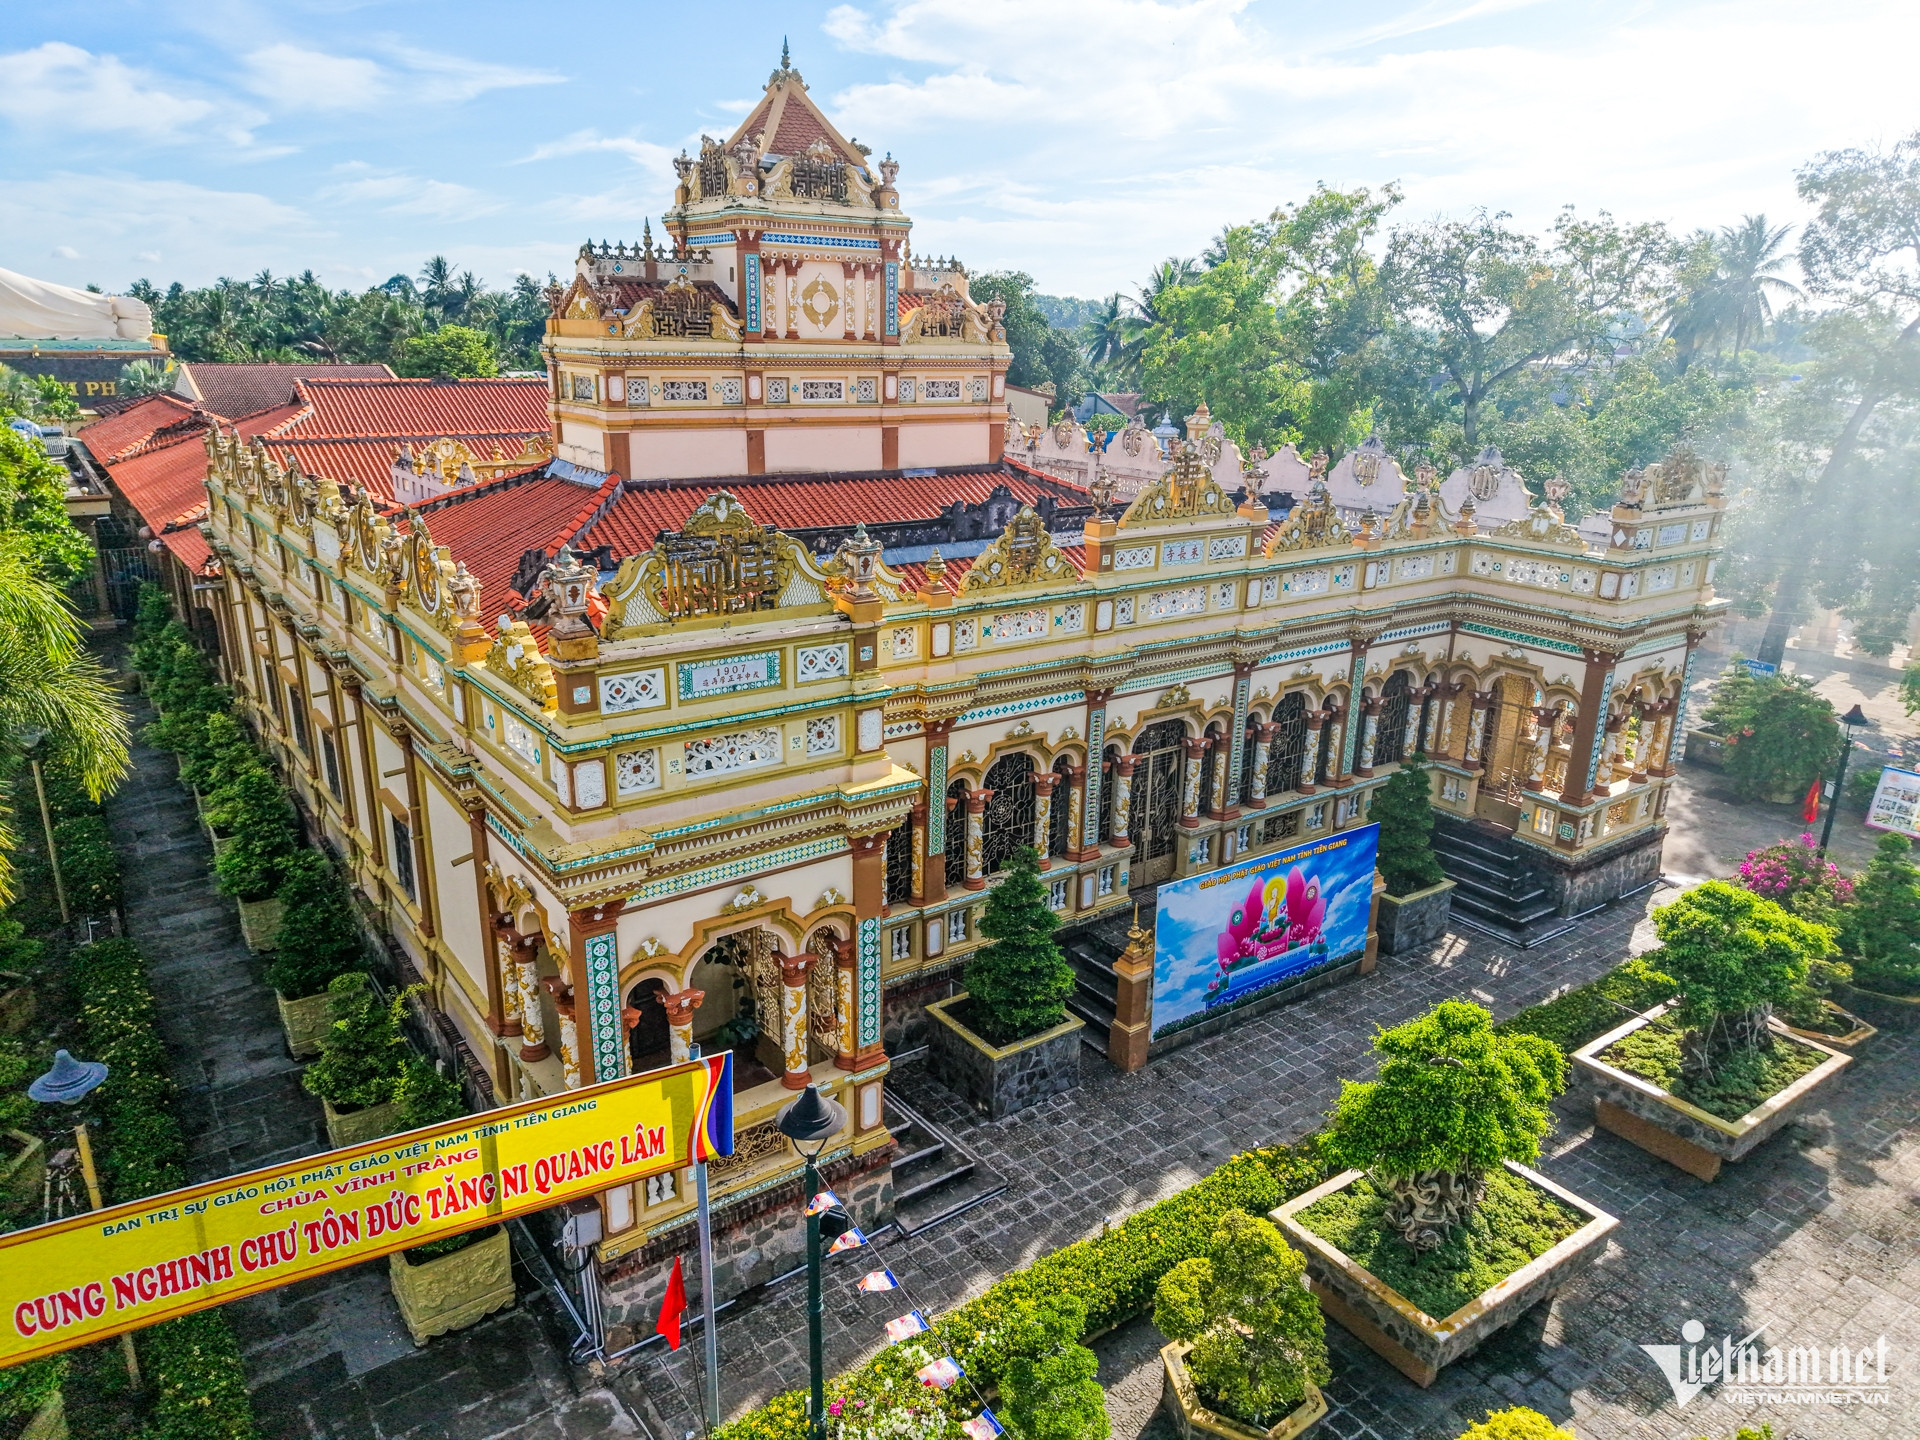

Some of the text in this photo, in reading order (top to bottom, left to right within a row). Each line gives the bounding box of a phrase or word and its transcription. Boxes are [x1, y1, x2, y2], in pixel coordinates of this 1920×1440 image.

[716, 664, 746, 677] 1907
[1199, 878, 1217, 890] GIÁO
[1217, 874, 1231, 884] HỘI
[1232, 868, 1249, 880] PHẬT
[1249, 863, 1266, 874] GIÁO
[1267, 858, 1281, 870] VIỆT
[1282, 855, 1297, 864] NAM
[1313, 844, 1327, 855] TIỀN
[1328, 838, 1347, 850] GIANG
[102, 1100, 597, 1237] BAN TRỊ SỰ GIÁO HỘI PHẬT GIÁO VIỆT NAM TỈNH TIỀN GIANG
[259, 1148, 479, 1215] CHÙA VĨNH TRÀNG
[14, 1123, 666, 1337] CUNG NGHINH CHƯ TÔN ĐỨC TĂNG NI QUANG LÂM
